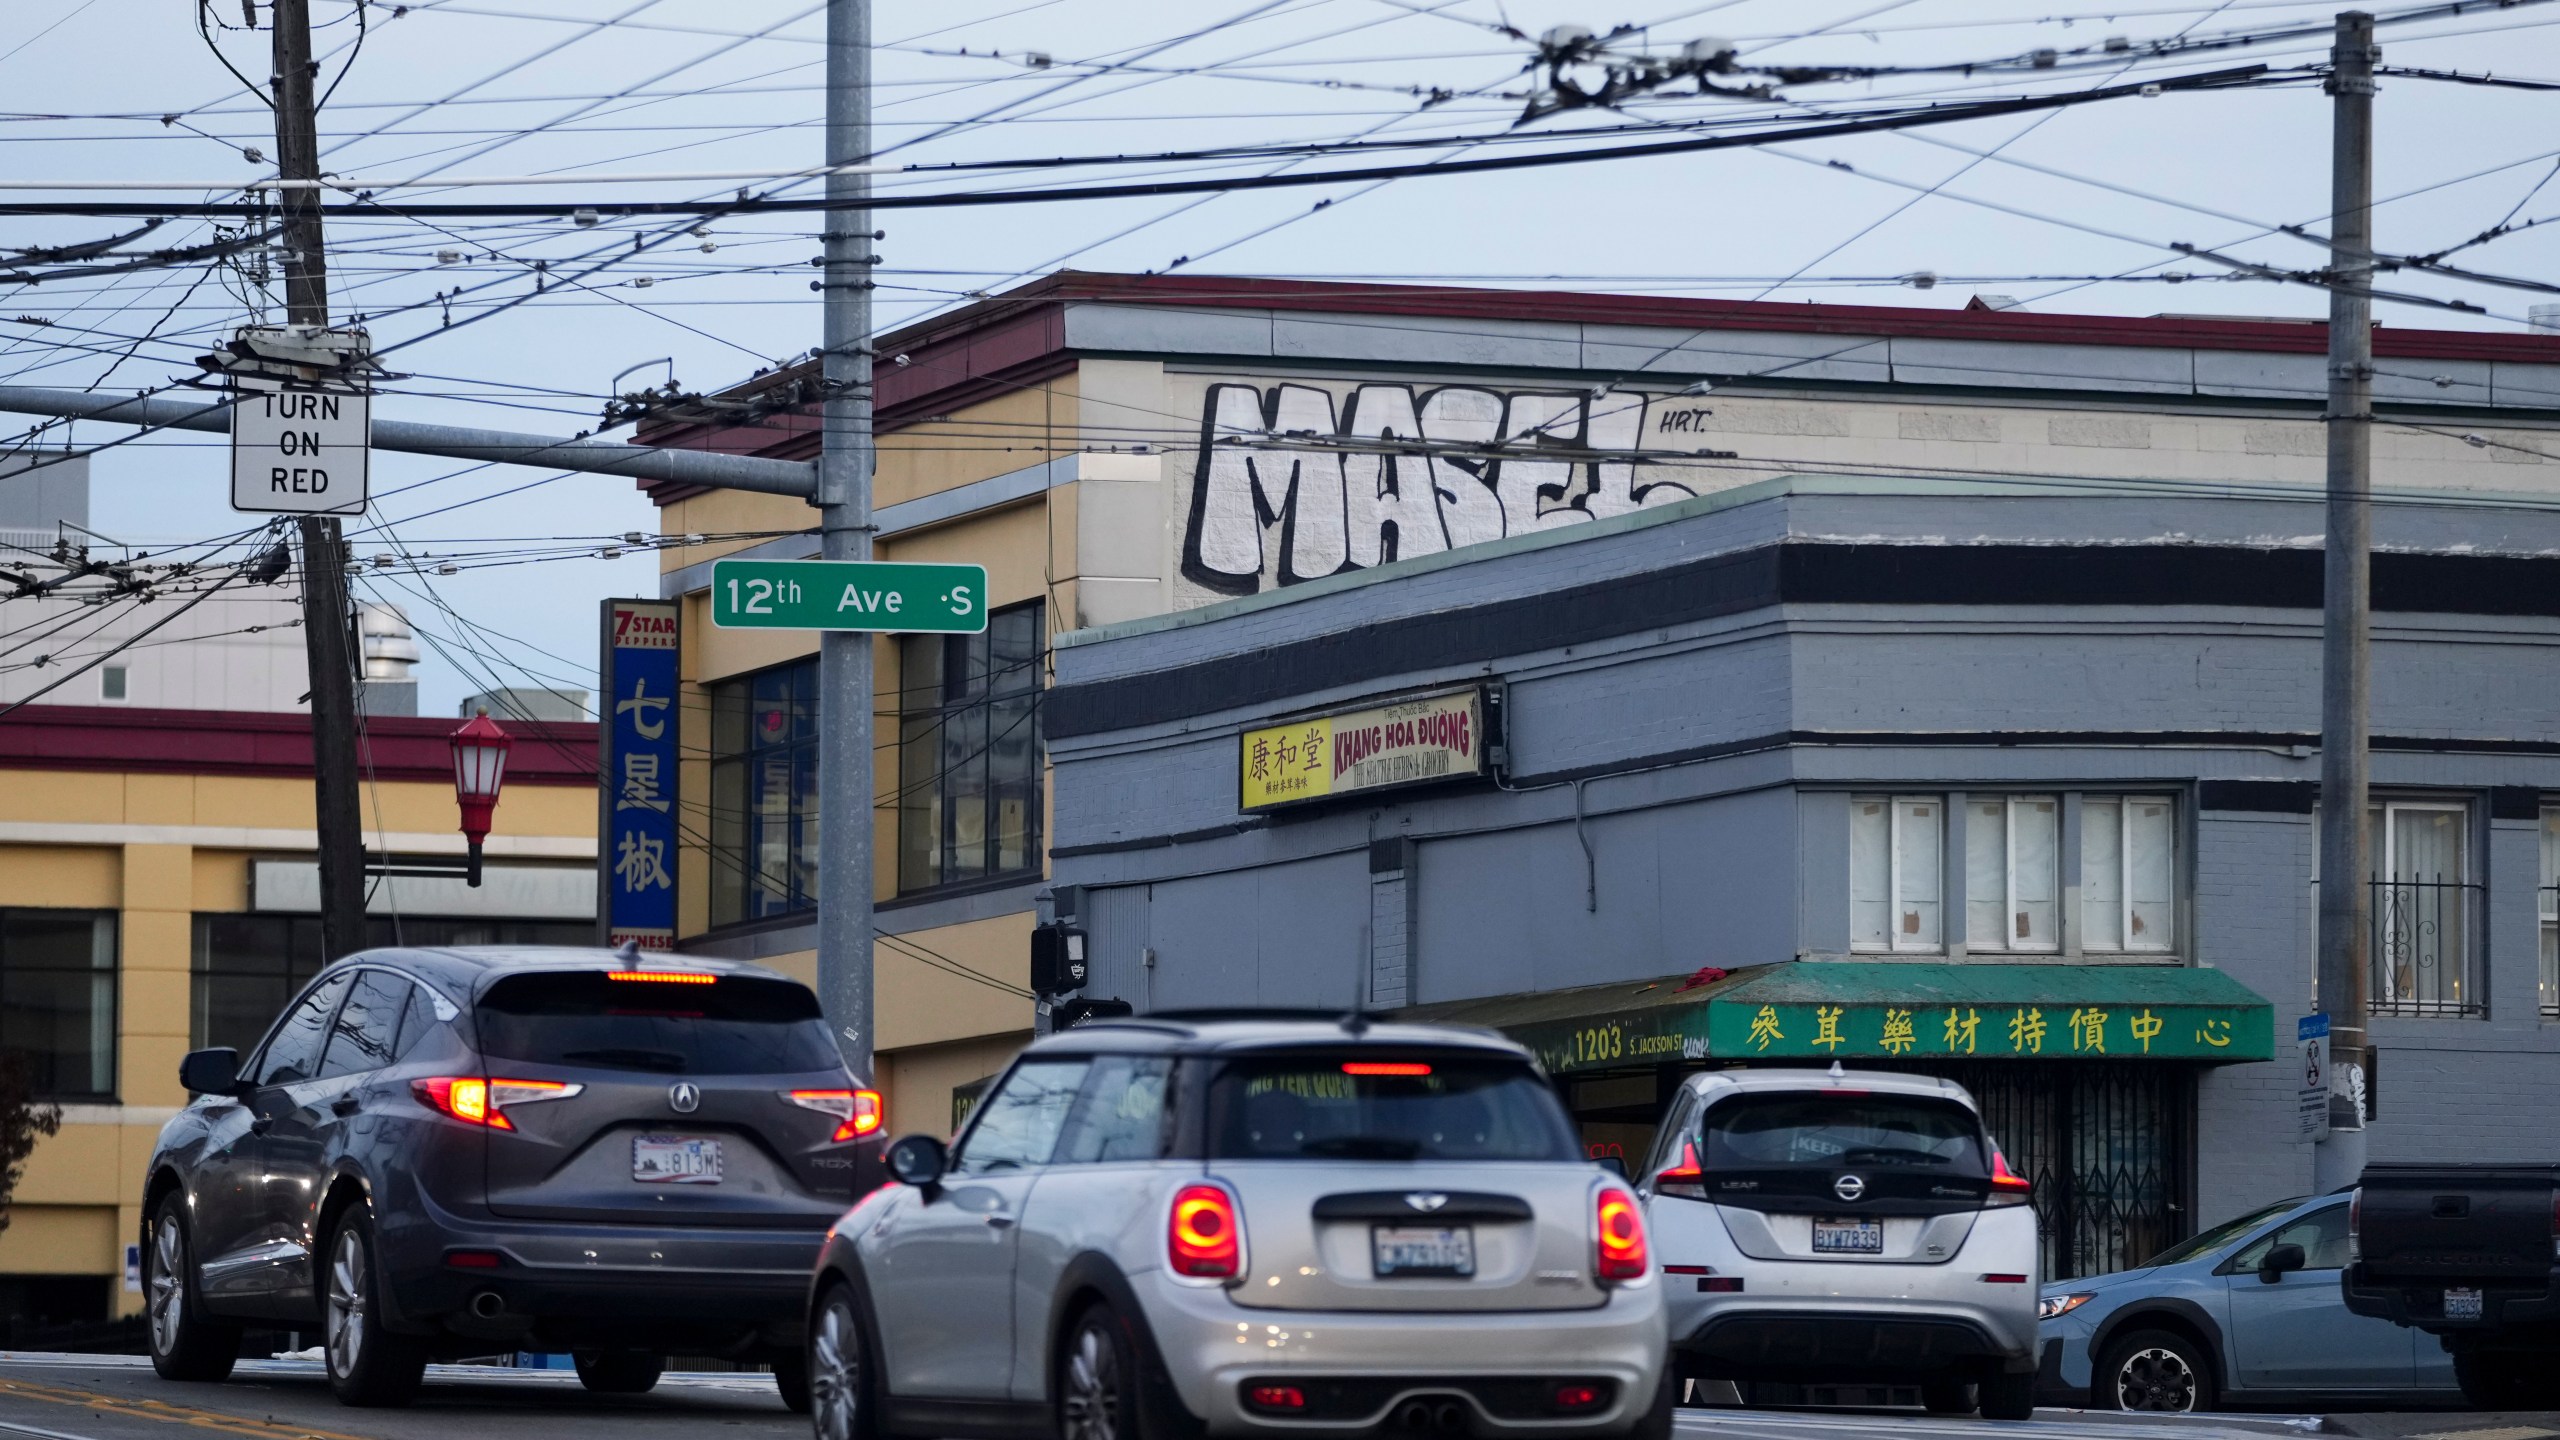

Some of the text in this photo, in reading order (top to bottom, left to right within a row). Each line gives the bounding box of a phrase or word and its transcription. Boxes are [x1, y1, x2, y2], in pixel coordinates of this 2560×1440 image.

[264, 393, 339, 420] TURN
[280, 430, 319, 457] ON
[271, 467, 329, 494] RED
[727, 578, 973, 616] 12th Ave S
[614, 636, 677, 647] PEPPERS
[1248, 727, 1325, 782] 康和堂
[1334, 708, 1470, 781] KHANG HÒA ĐƯỜNG
[1421, 748, 1450, 777] GROCERY
[615, 676, 672, 893] 七星椒
[1575, 1025, 1622, 1062] 1203
[1629, 1038, 1638, 1056] S.
[1639, 1035, 1673, 1055] JACKSON
[1749, 1004, 2232, 1055] 參茸藥材特價中心
[1720, 1181, 1760, 1190] LEAF
